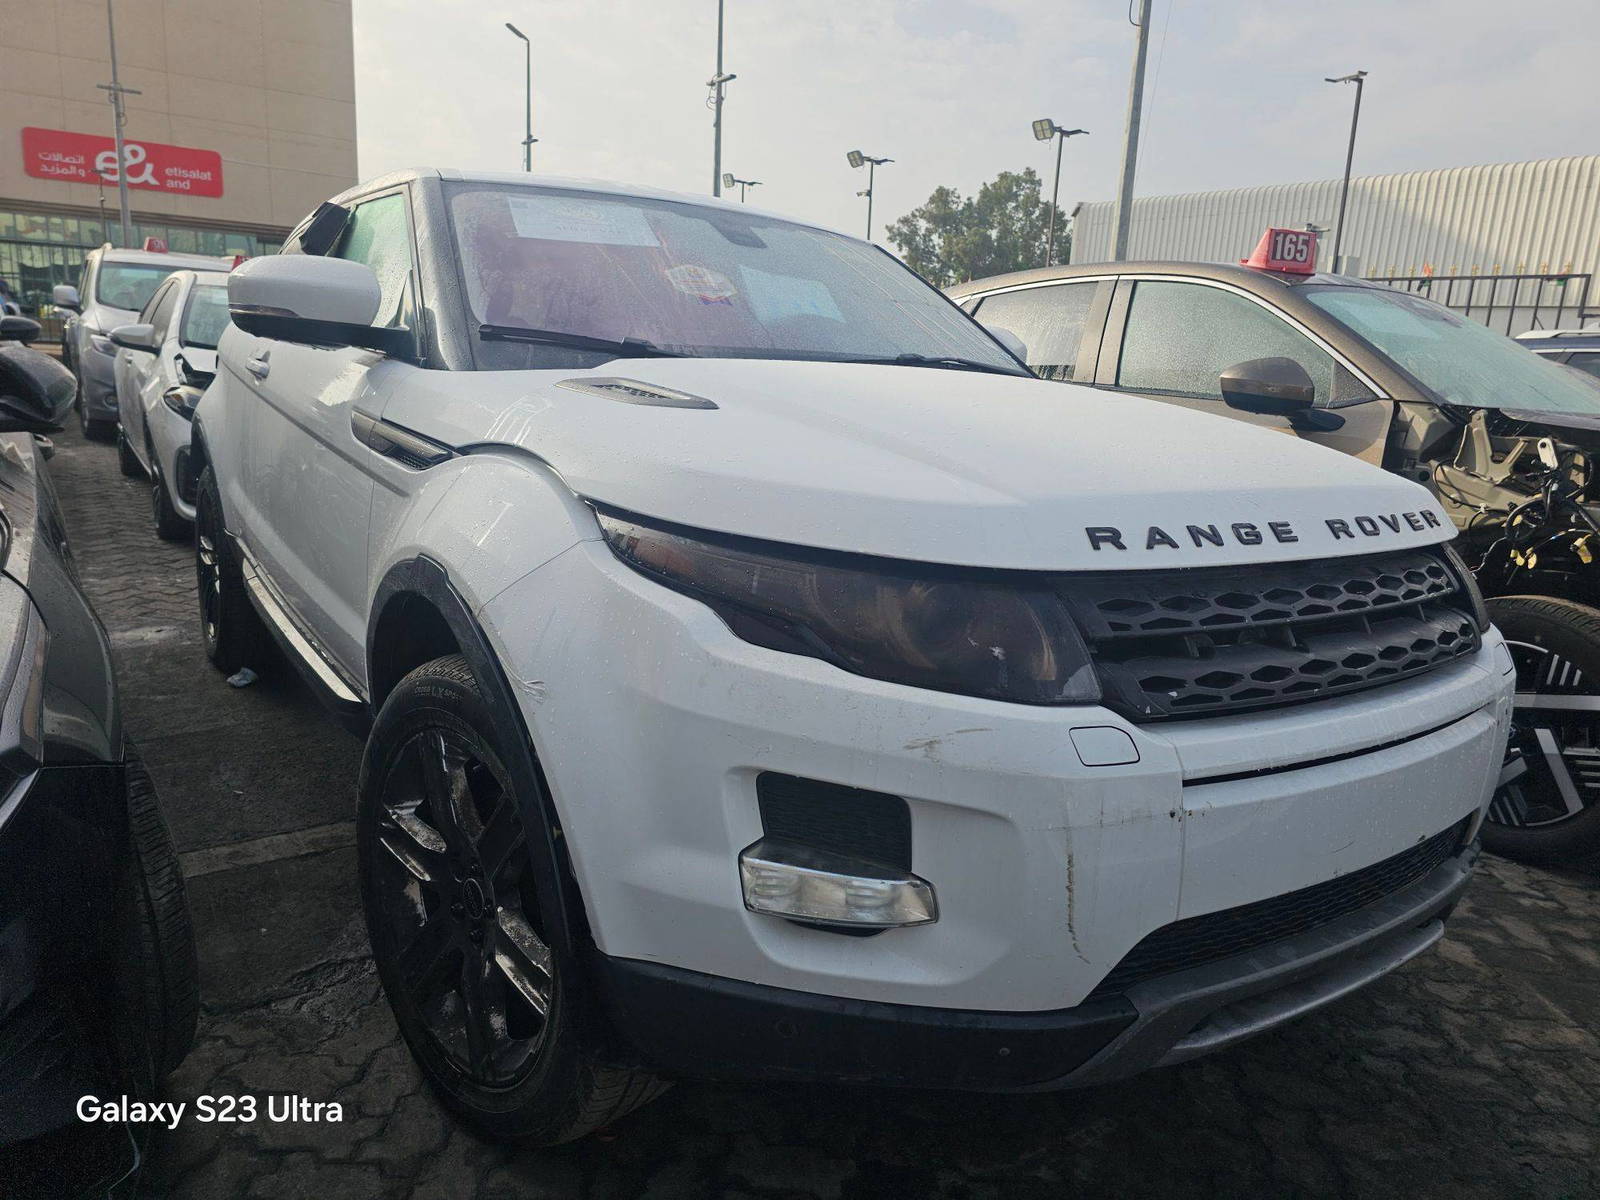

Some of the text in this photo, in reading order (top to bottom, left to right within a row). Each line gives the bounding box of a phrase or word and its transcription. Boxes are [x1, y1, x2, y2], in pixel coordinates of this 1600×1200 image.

[38, 151, 85, 165] اتصالات
[164, 167, 212, 181] etisalat
[166, 179, 191, 190] and
[1275, 232, 1309, 262] 165
[1085, 509, 1441, 551] RANGE ROVER
